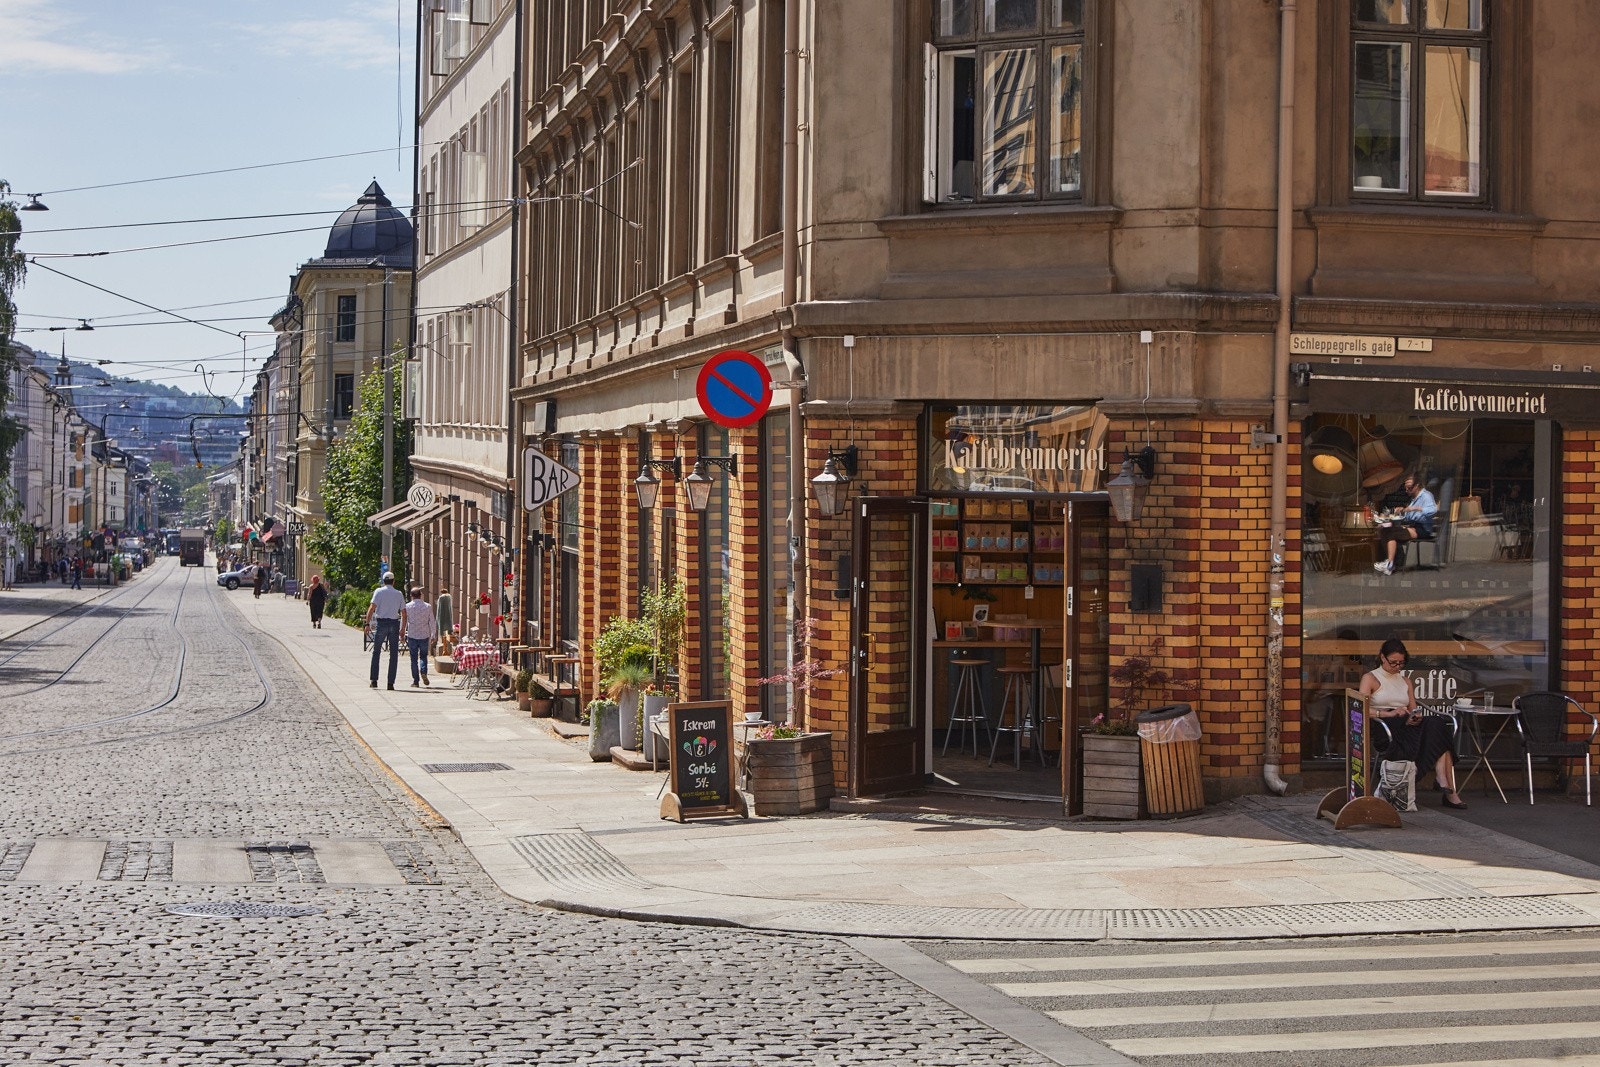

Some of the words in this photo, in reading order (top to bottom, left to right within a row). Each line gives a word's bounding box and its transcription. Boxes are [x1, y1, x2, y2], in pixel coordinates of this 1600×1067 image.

[1293, 336, 1367, 354] Schleppegrells
[1371, 340, 1392, 355] gate
[1414, 387, 1547, 414] Kaffebrenneriet
[944, 439, 1108, 471] Kaffebrenneriet
[531, 454, 569, 505] BAR
[683, 719, 716, 731] Iskrem
[688, 762, 717, 776] Sorbé
